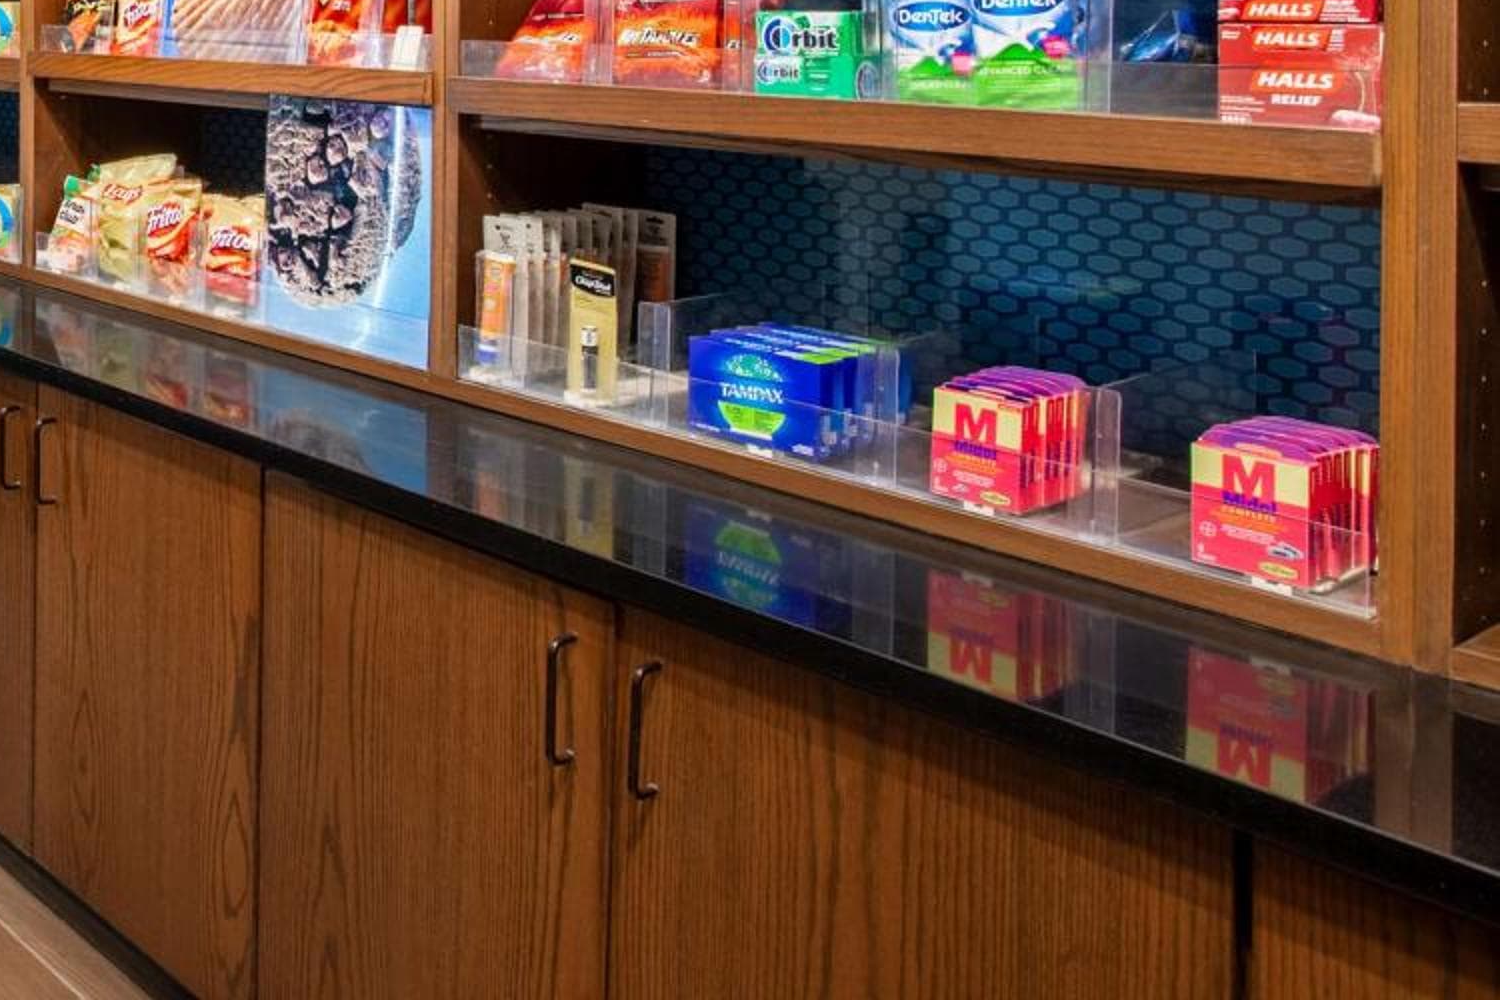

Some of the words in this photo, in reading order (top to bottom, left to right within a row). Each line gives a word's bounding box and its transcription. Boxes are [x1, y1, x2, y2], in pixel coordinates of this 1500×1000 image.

[899, 8, 963, 25] DenTek
[1248, 3, 1314, 17] HALLS
[762, 18, 837, 54] Orbit
[1254, 32, 1320, 47] HALLS
[757, 61, 799, 82] Orbit
[1257, 72, 1333, 89] HALLS
[1271, 94, 1323, 106] RELIEF
[720, 381, 784, 405] TAMPAX
[955, 402, 997, 444] M
[1222, 454, 1275, 503] M
